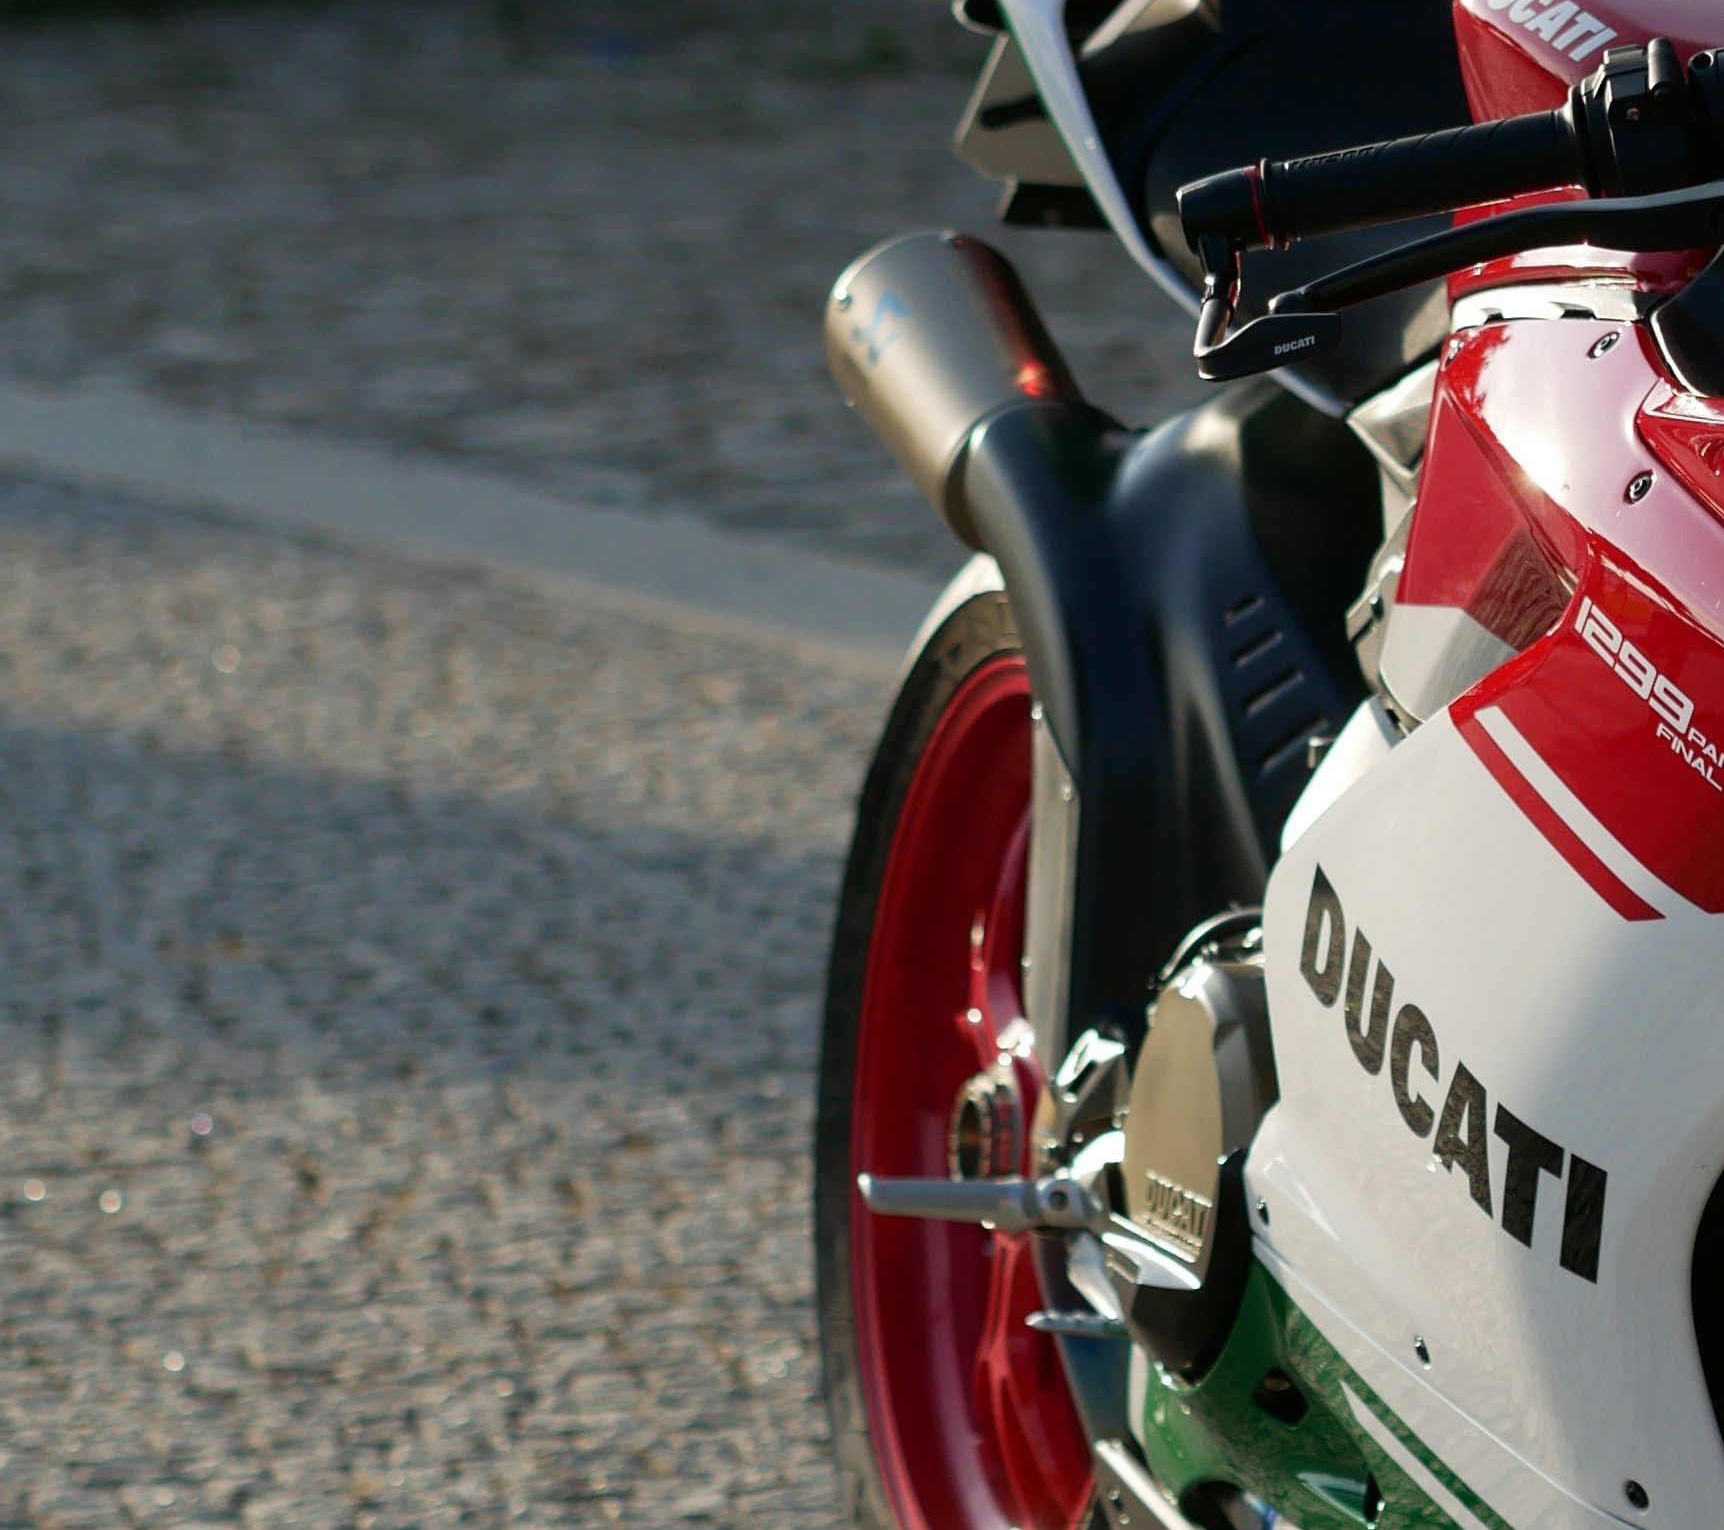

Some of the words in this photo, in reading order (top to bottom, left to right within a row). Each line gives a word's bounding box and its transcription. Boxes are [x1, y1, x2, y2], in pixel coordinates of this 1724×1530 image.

[1274, 335, 1315, 355] DUCATI
[1574, 596, 1694, 734] 1299
[1656, 722, 1723, 792] FINAL
[1299, 862, 1608, 1284] DUCATI
[1145, 1169, 1213, 1242] DUCATI
